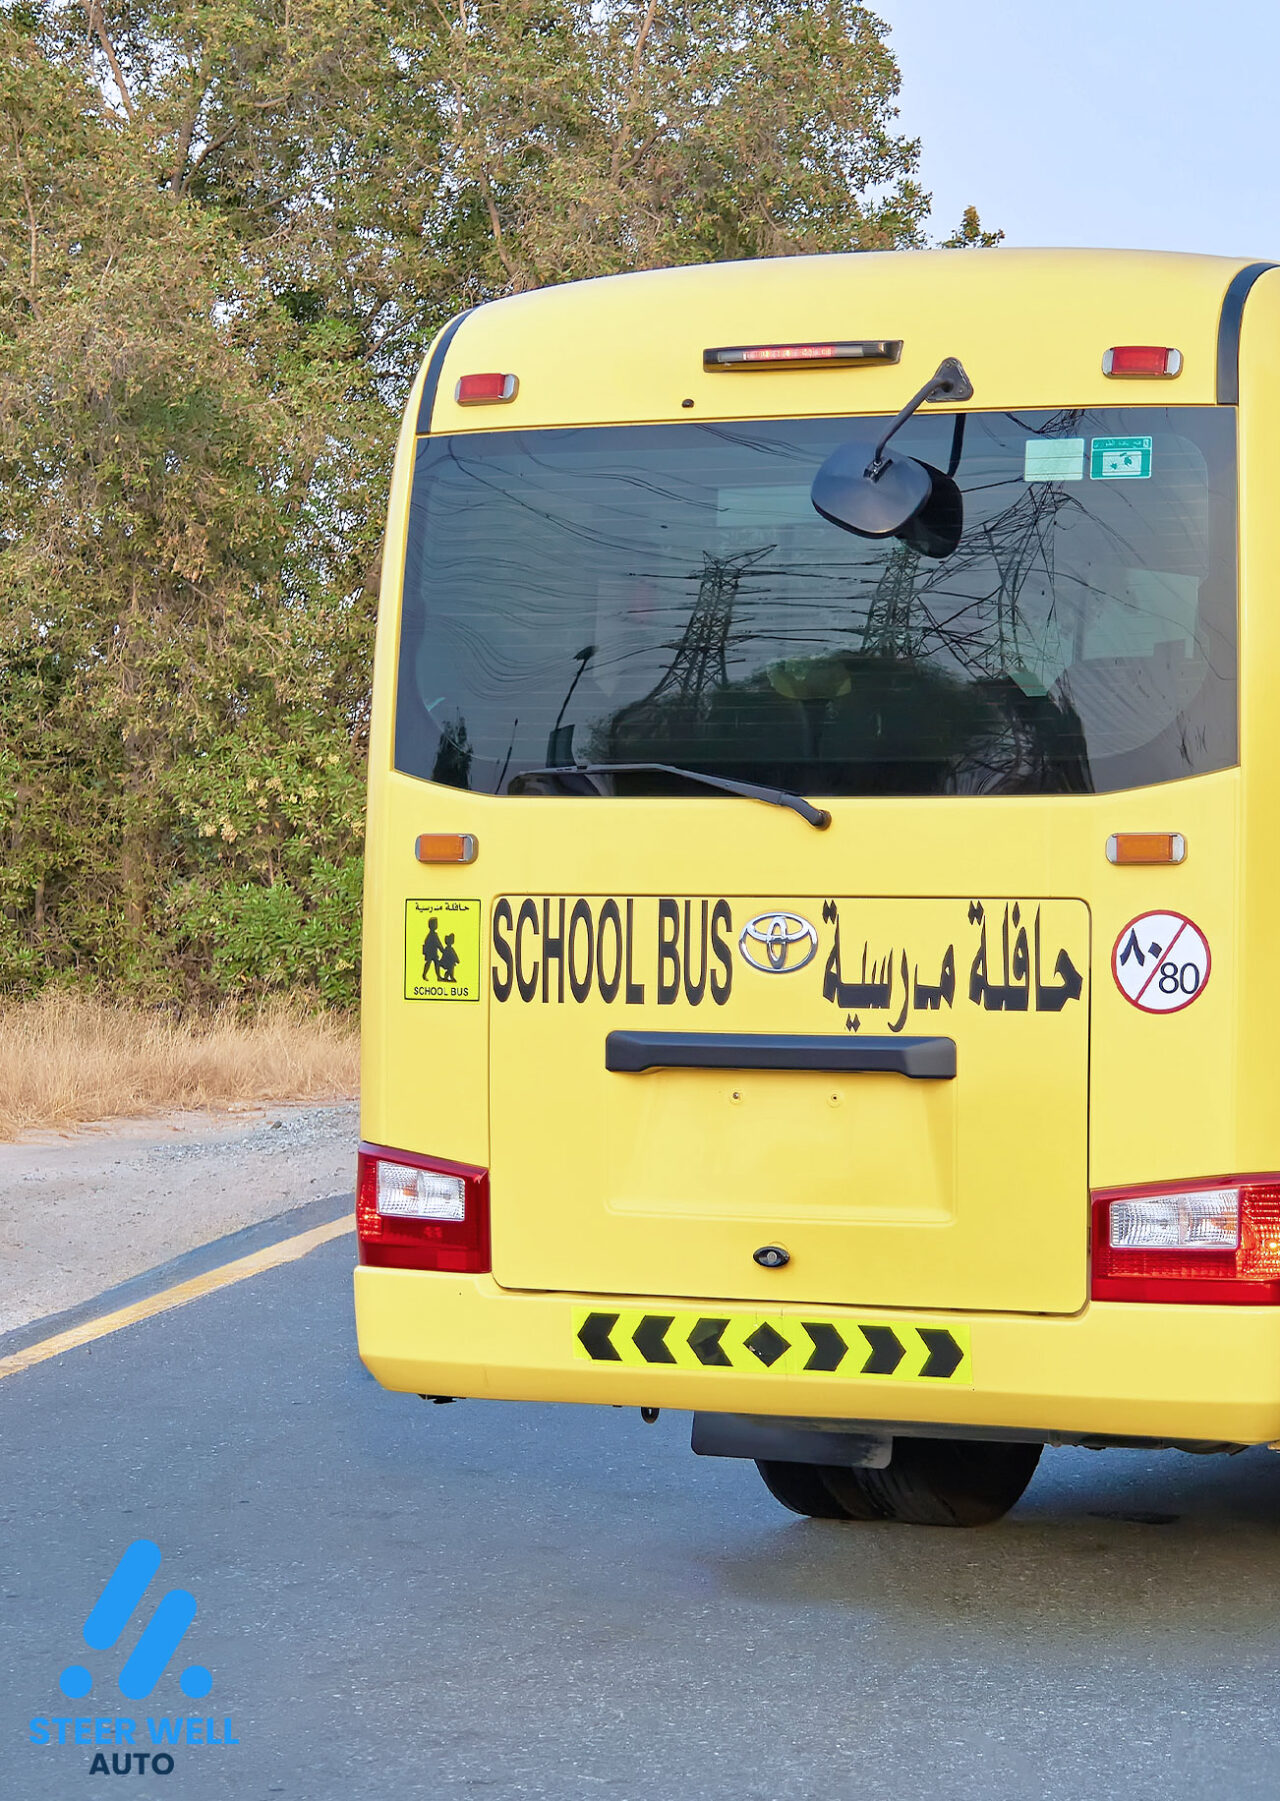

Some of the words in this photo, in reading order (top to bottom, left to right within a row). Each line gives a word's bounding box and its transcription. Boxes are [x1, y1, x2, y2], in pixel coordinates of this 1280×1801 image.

[415, 902, 443, 913] مدرسية
[445, 902, 470, 911] حافلة
[491, 897, 645, 1004] SCHOOL
[657, 898, 733, 1006] BUS
[968, 900, 1084, 1012] حافلة
[1119, 927, 1163, 967] ٨٠
[822, 899, 956, 1033] مدرسية
[1158, 961, 1200, 995] 80
[413, 986, 448, 996] SCHOOL
[450, 987, 469, 996] BUS
